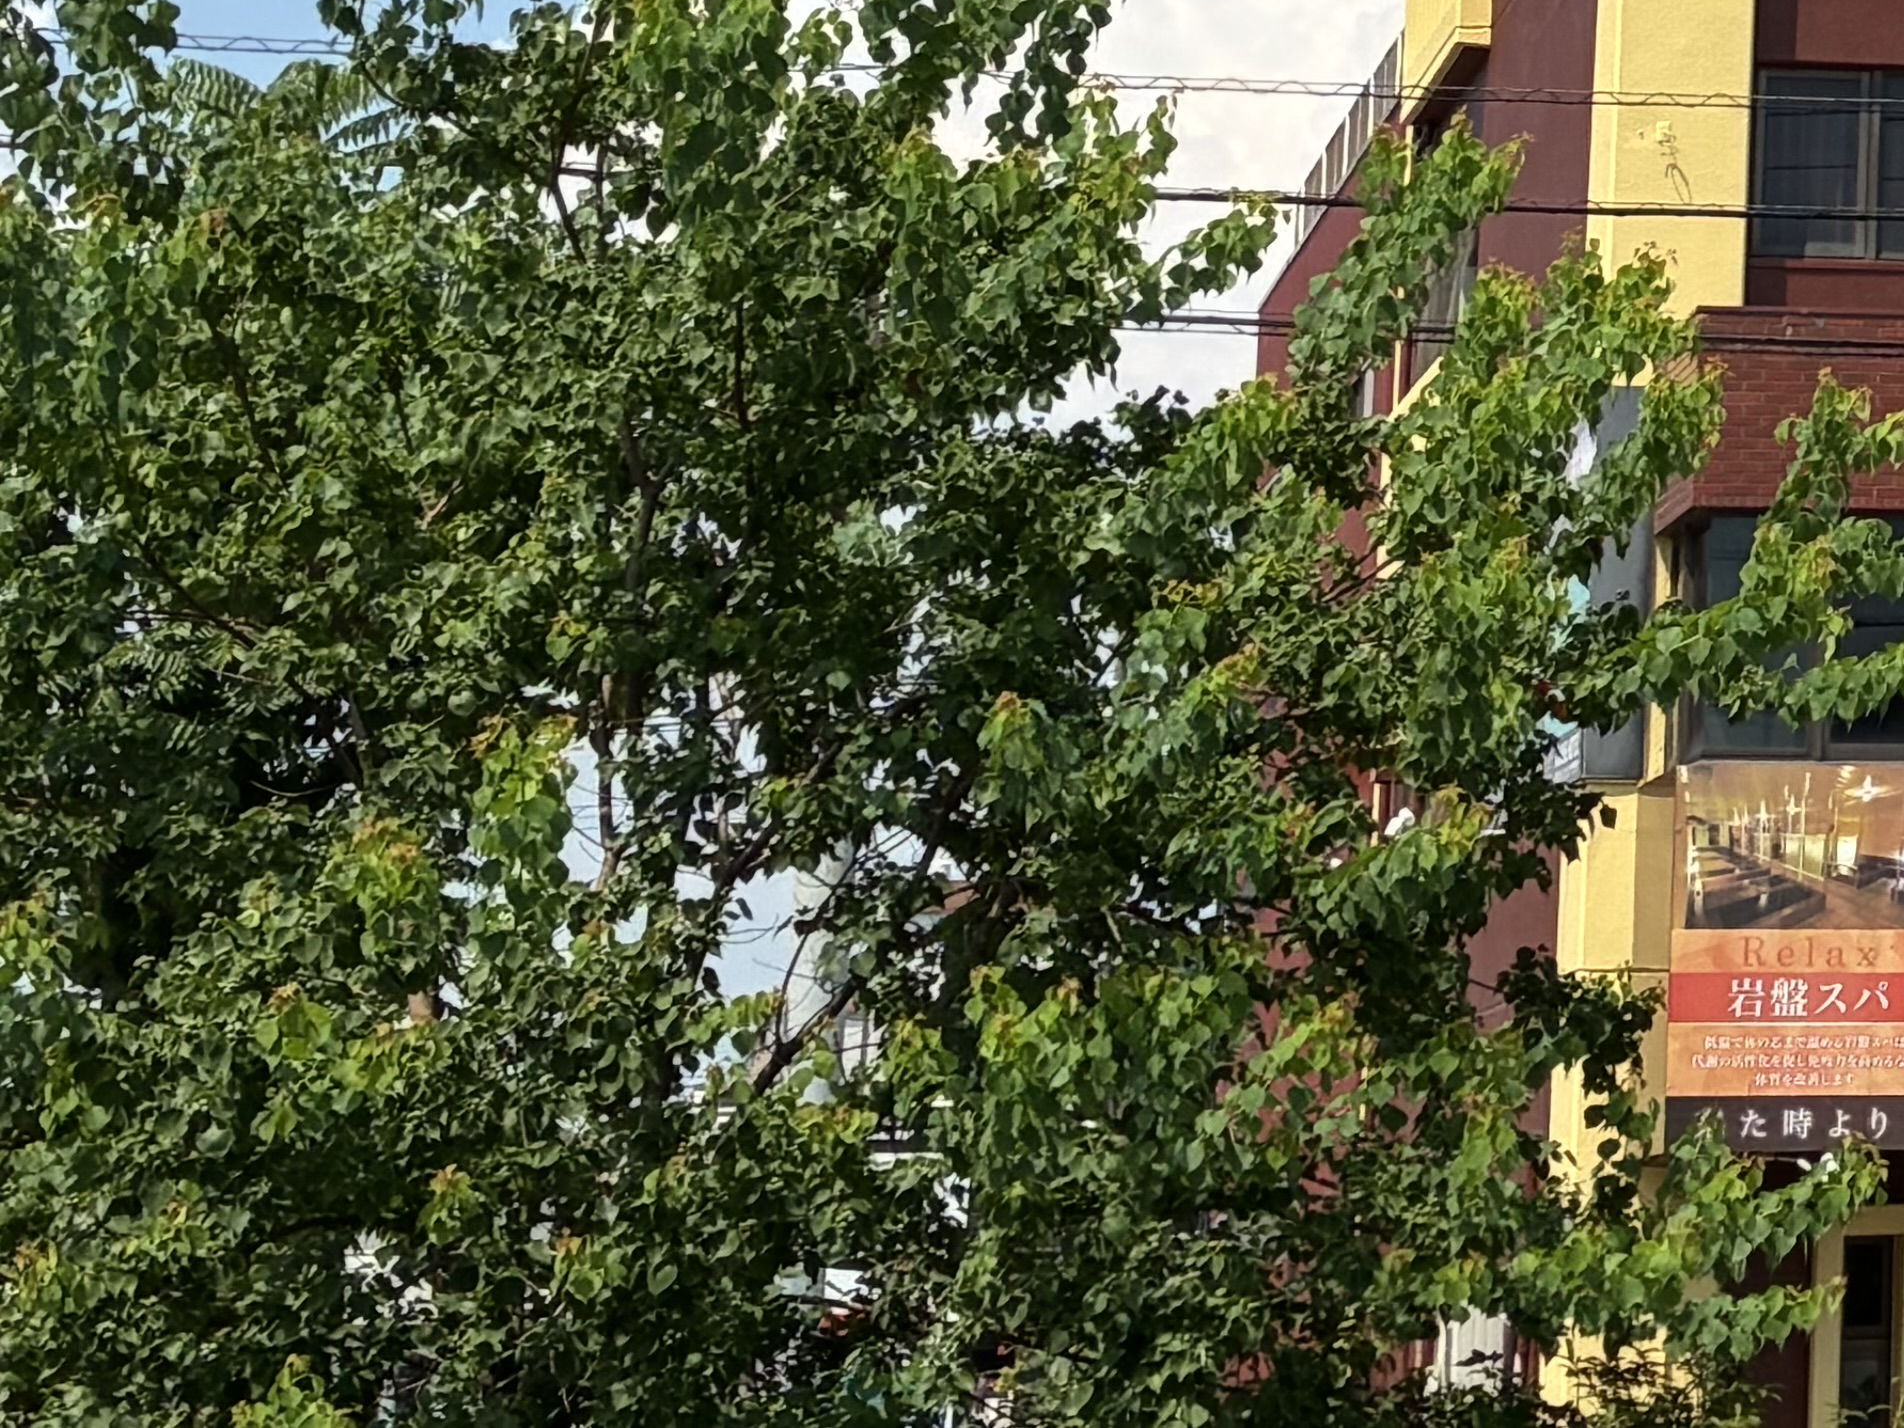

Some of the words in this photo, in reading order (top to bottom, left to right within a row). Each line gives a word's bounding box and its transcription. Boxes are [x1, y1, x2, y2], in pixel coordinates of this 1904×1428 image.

[1741, 936, 1880, 969] Relax
[1727, 976, 1890, 1019] 岩盤スパ
